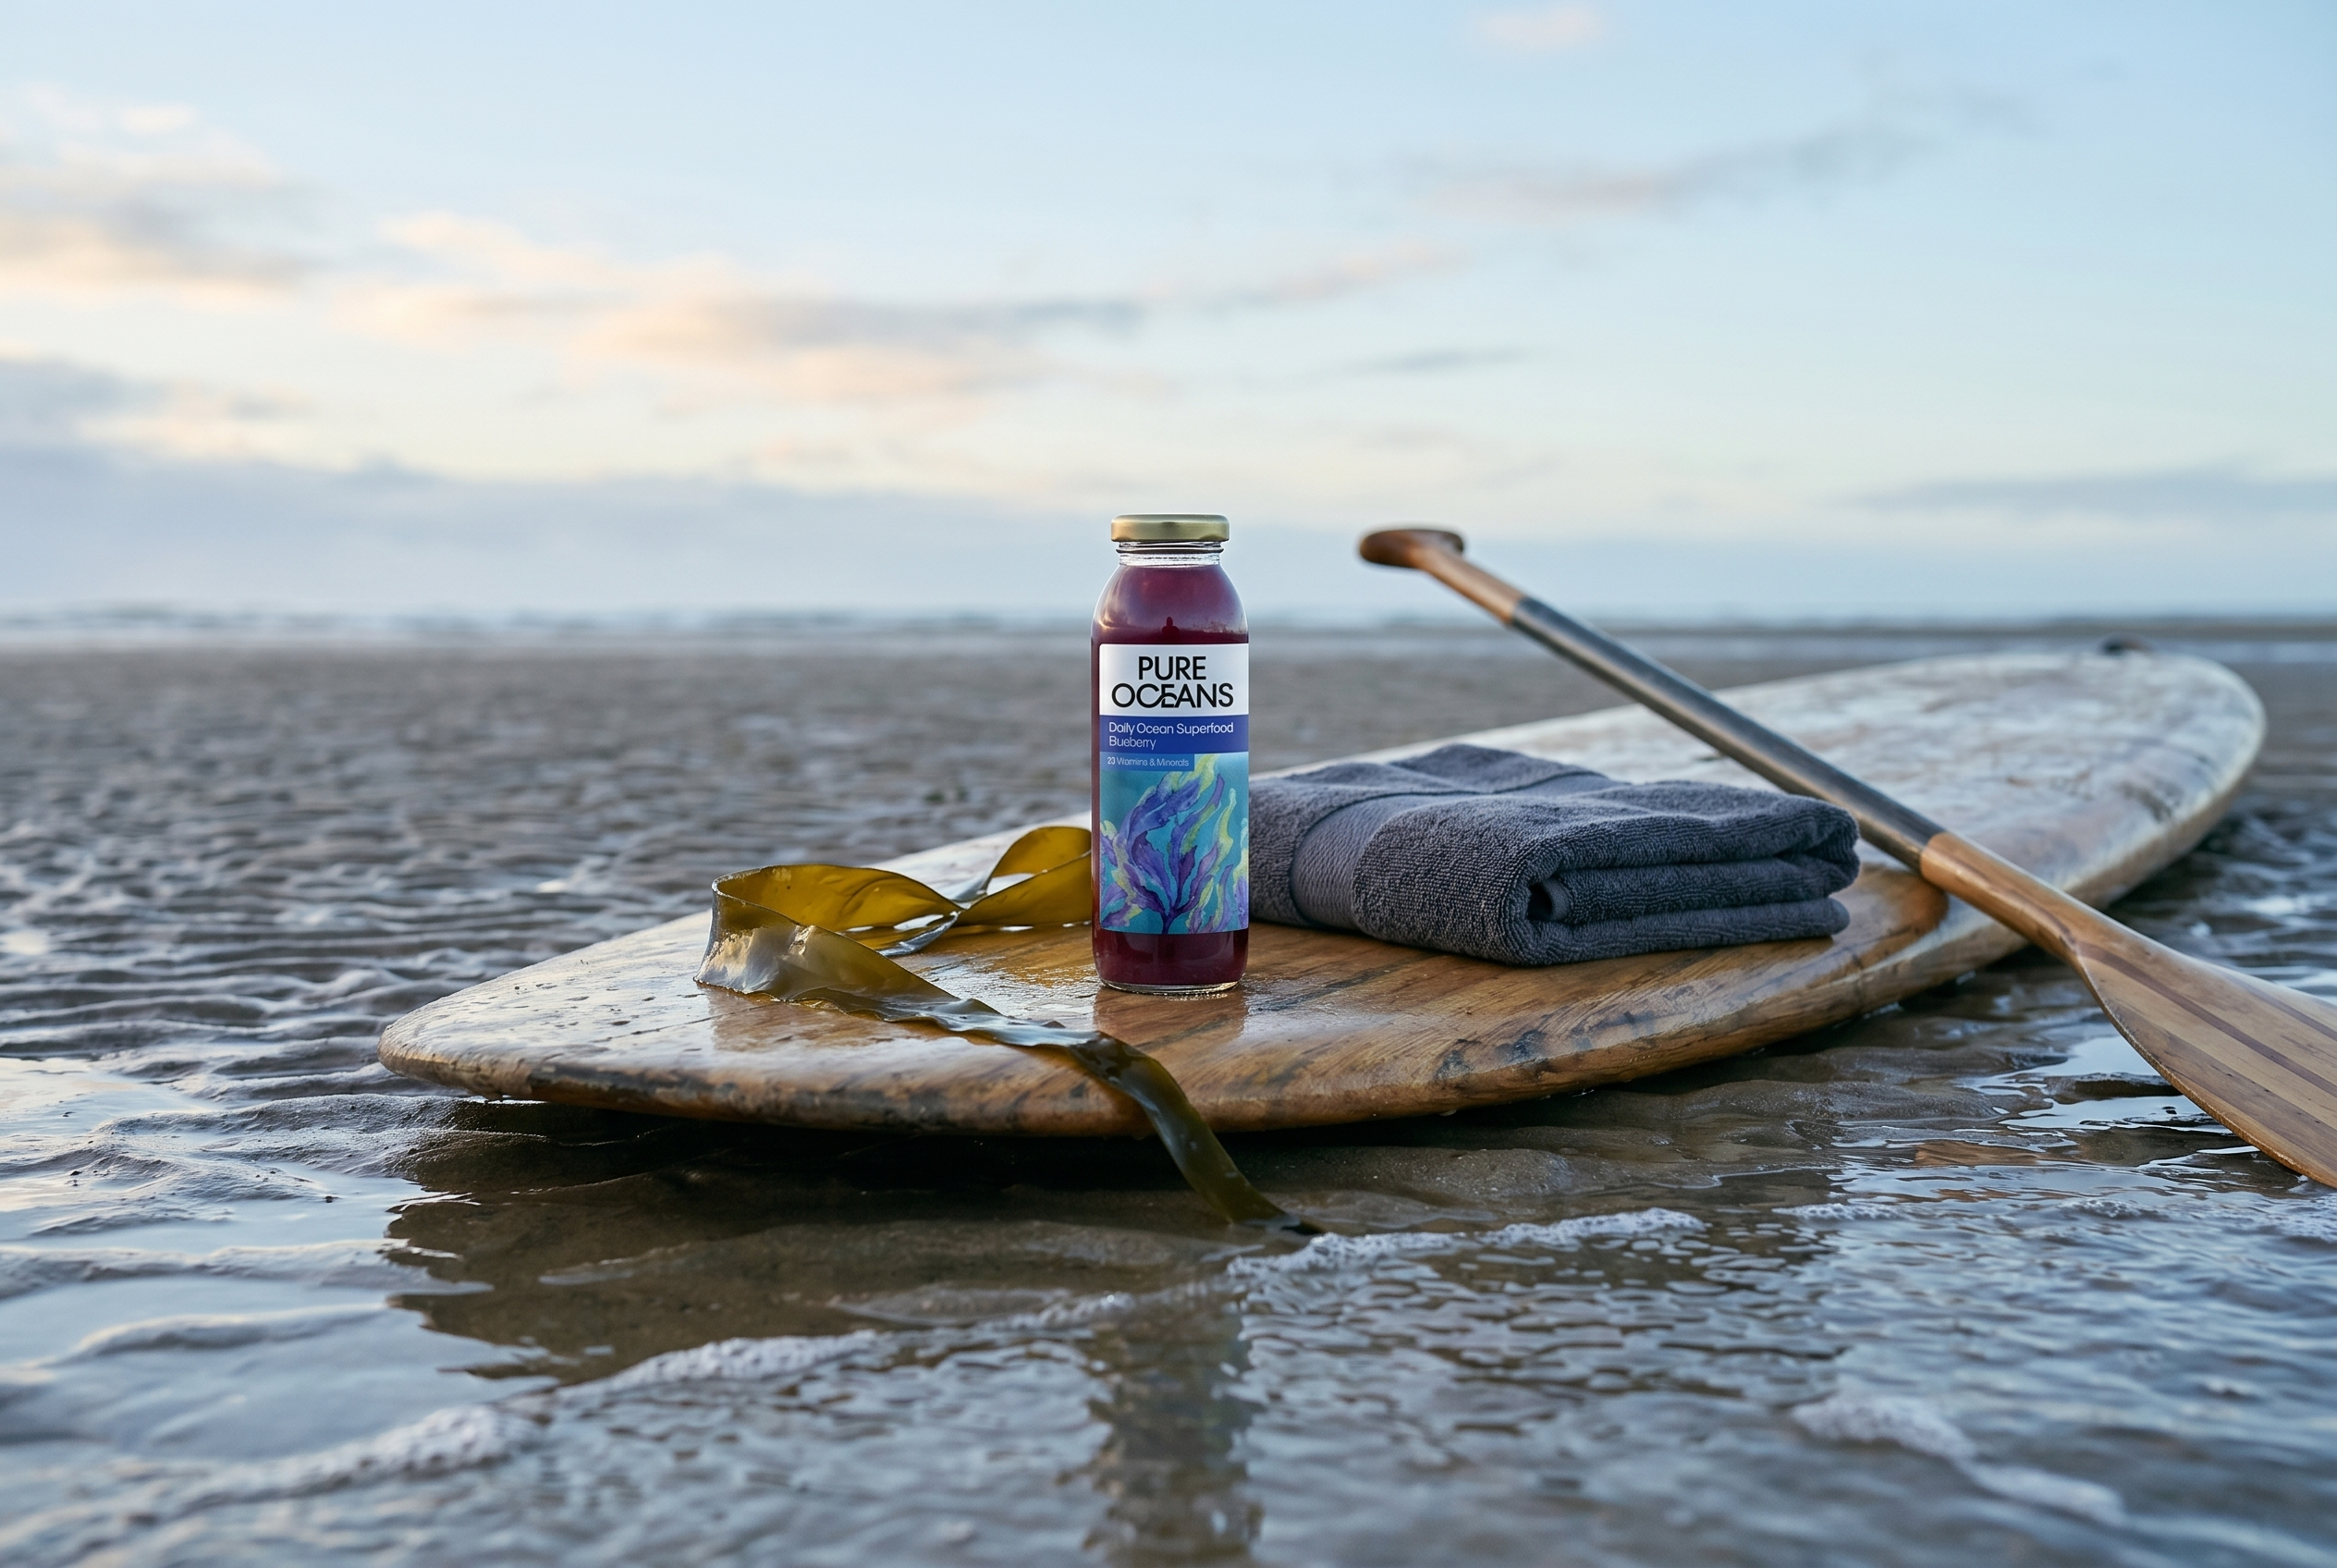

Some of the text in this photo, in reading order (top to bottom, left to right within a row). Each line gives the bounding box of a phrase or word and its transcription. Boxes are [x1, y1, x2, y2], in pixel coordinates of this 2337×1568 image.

[1138, 655, 1206, 680] PURE
[1111, 682, 1234, 708] OCEANS
[1108, 722, 1234, 737] Daily Ocean Superfood
[1149, 758, 1156, 766] &
